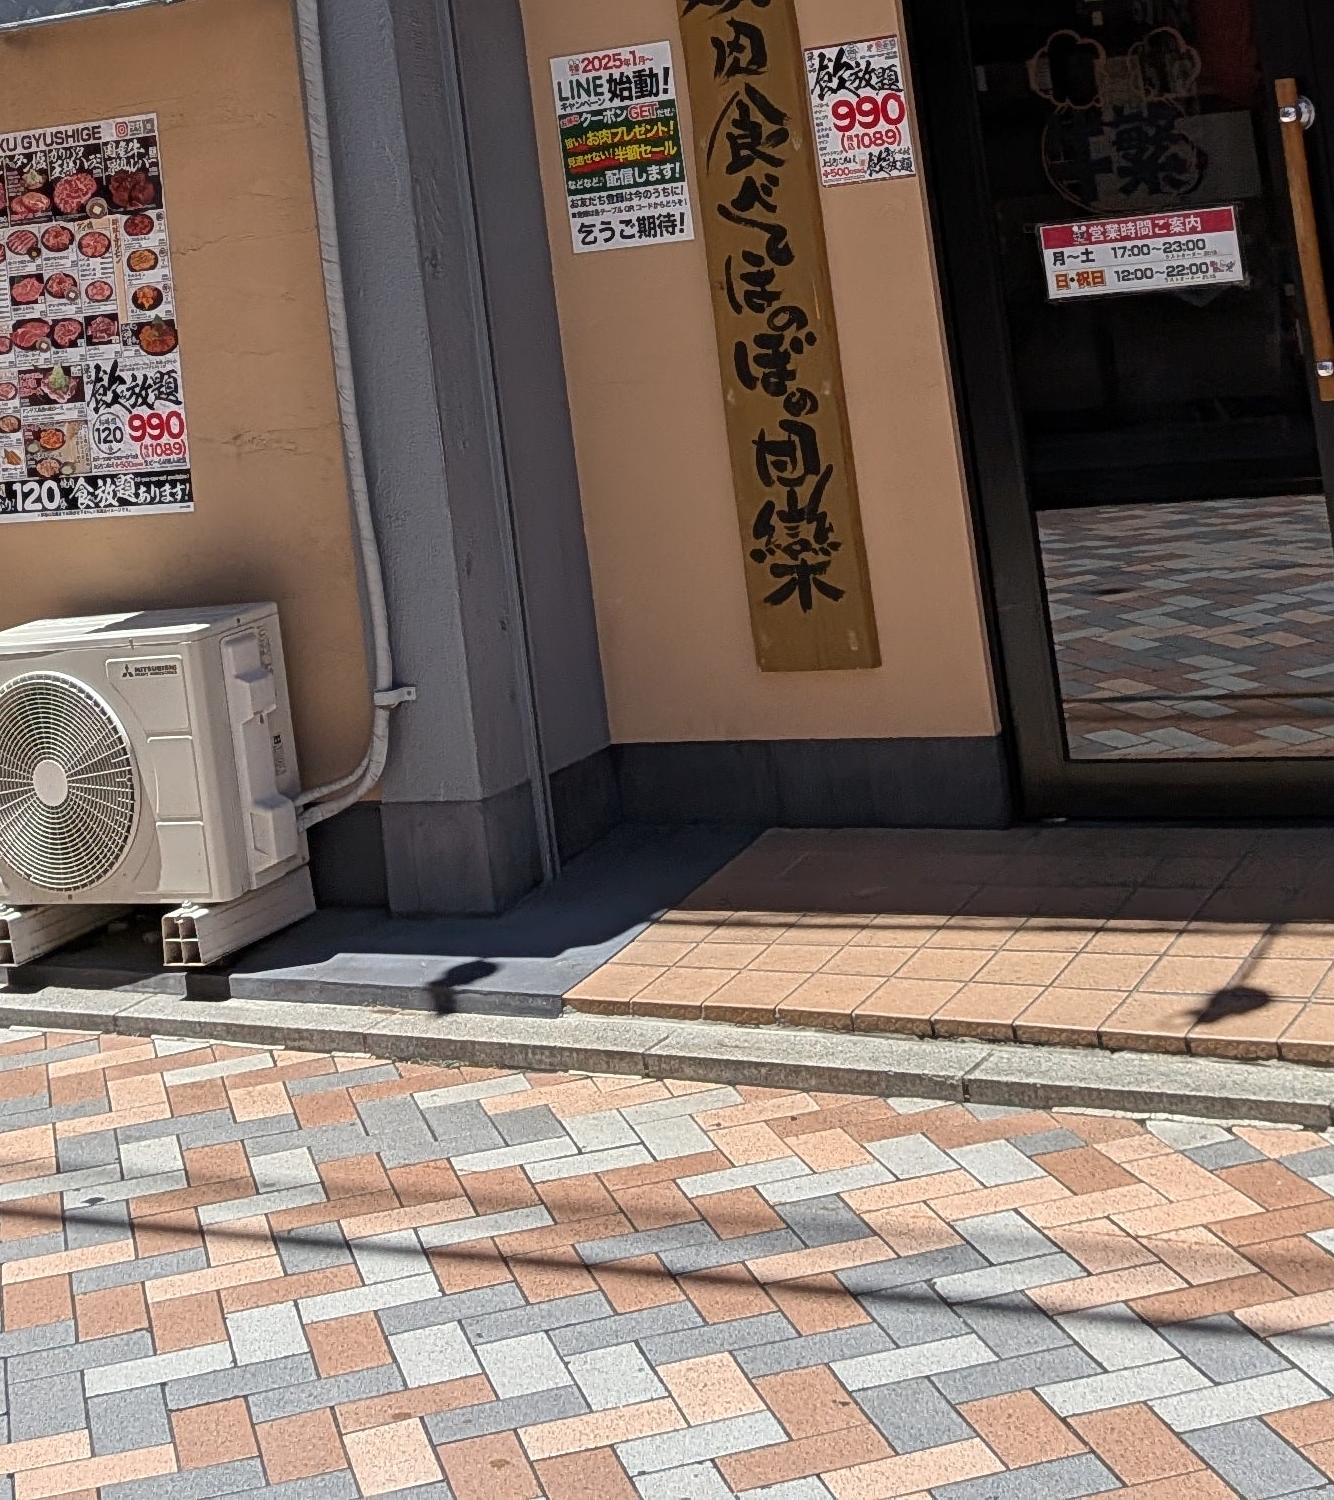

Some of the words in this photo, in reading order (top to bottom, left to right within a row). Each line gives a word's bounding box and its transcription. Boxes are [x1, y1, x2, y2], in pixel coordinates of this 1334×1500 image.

[557, 75, 604, 102] LINE
[831, 92, 905, 132] 990
[20, 124, 102, 151] GYUSHIGE
[1089, 215, 1203, 241] 営業時間ご案内
[95, 425, 124, 445] 120
[128, 410, 185, 443] 990
